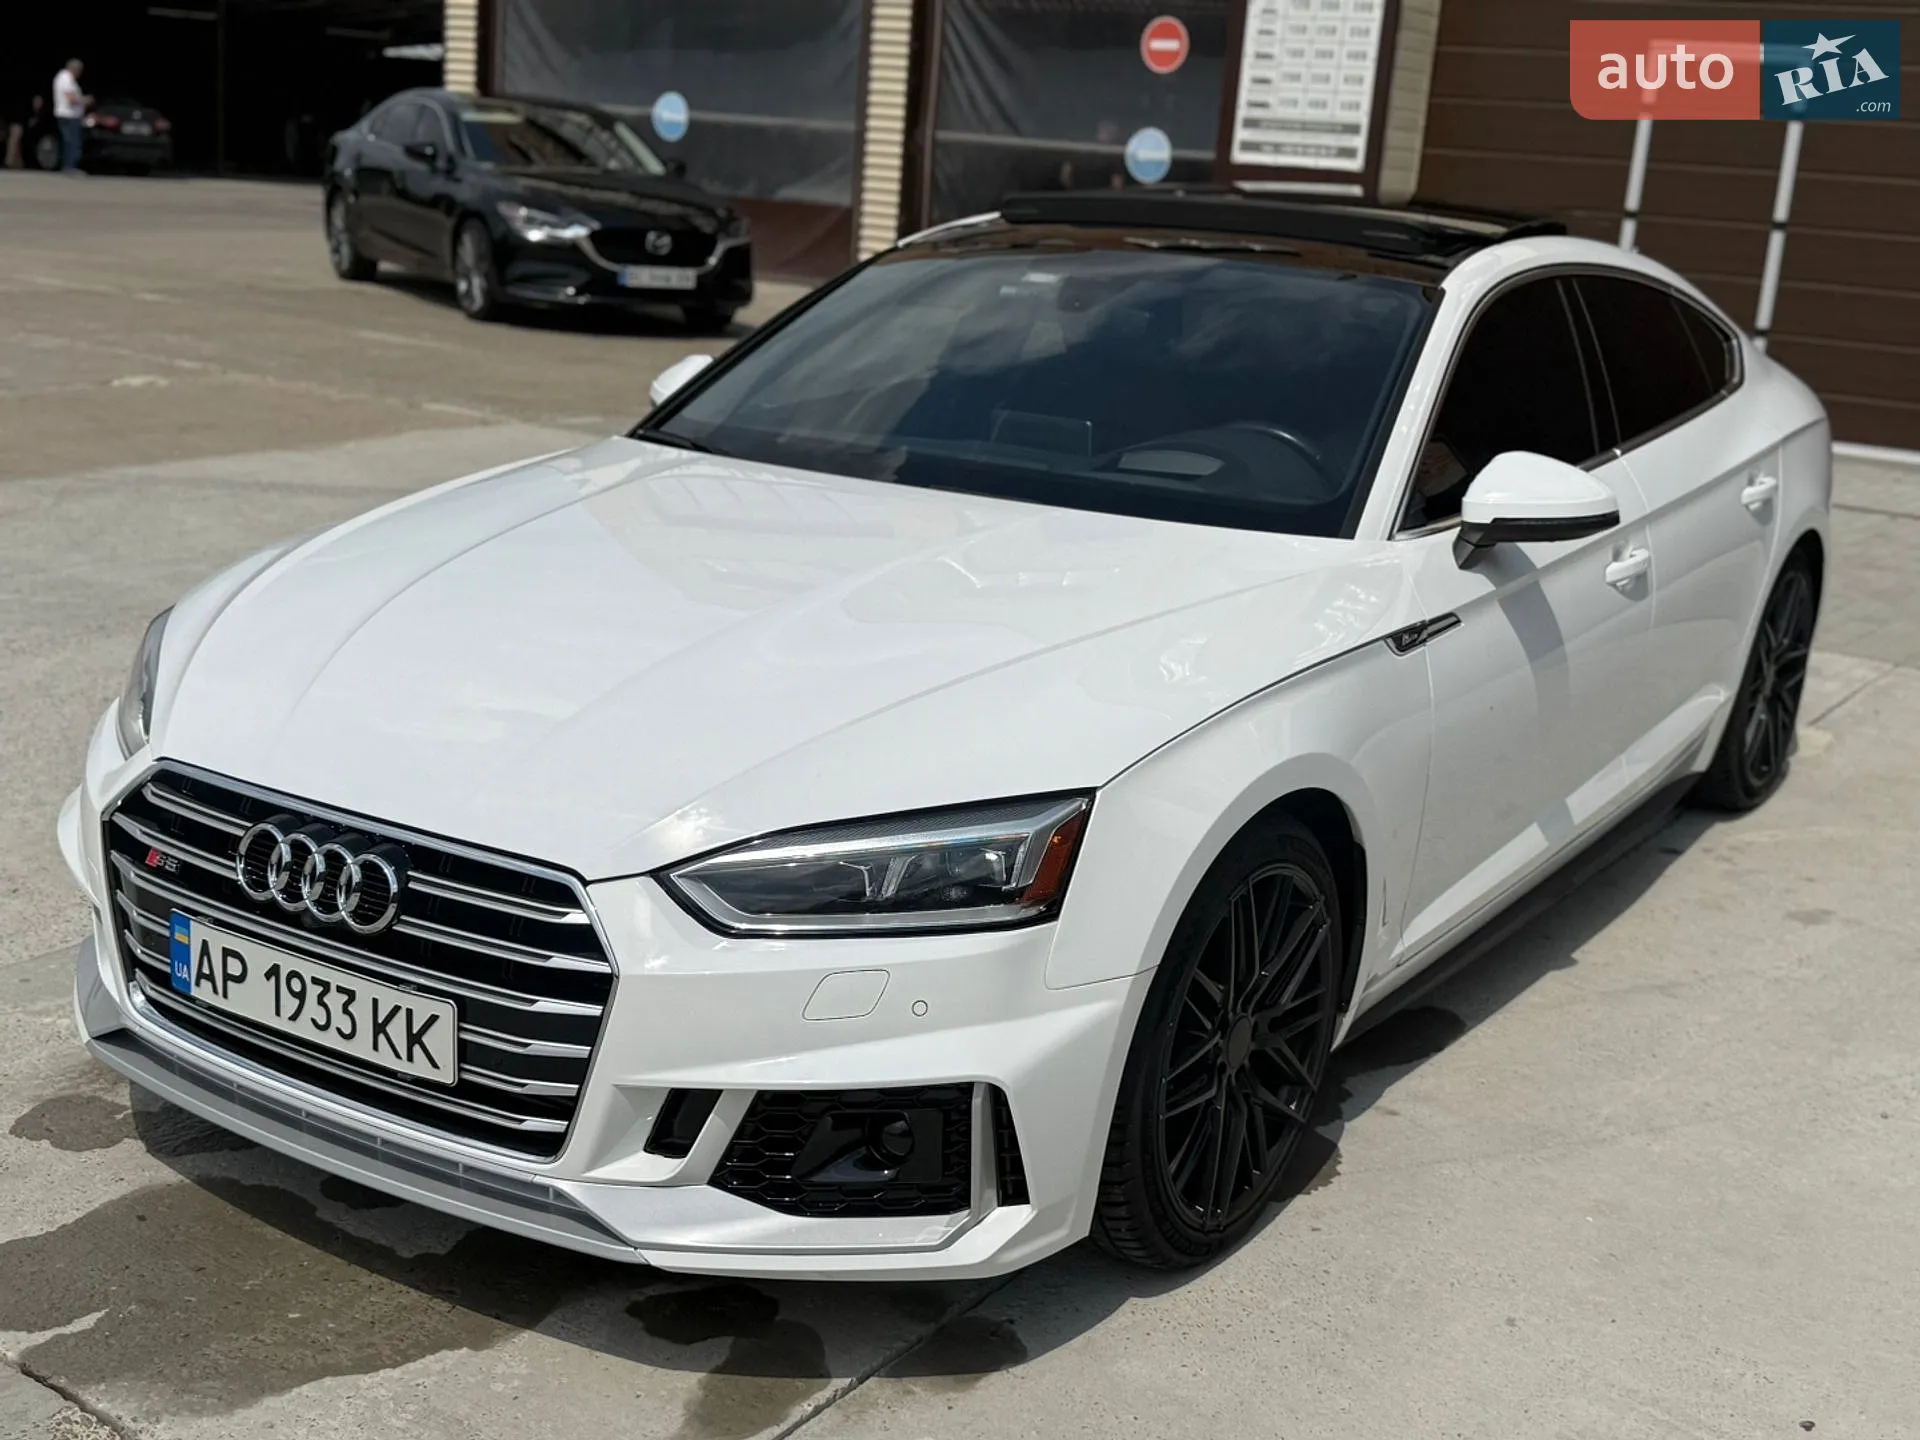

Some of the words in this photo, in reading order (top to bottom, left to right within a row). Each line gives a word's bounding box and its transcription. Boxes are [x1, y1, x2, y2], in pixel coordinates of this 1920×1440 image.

[174, 963, 190, 983] UA
[195, 938, 248, 999] AP
[264, 963, 357, 1040] 1933
[372, 997, 440, 1069] KK
